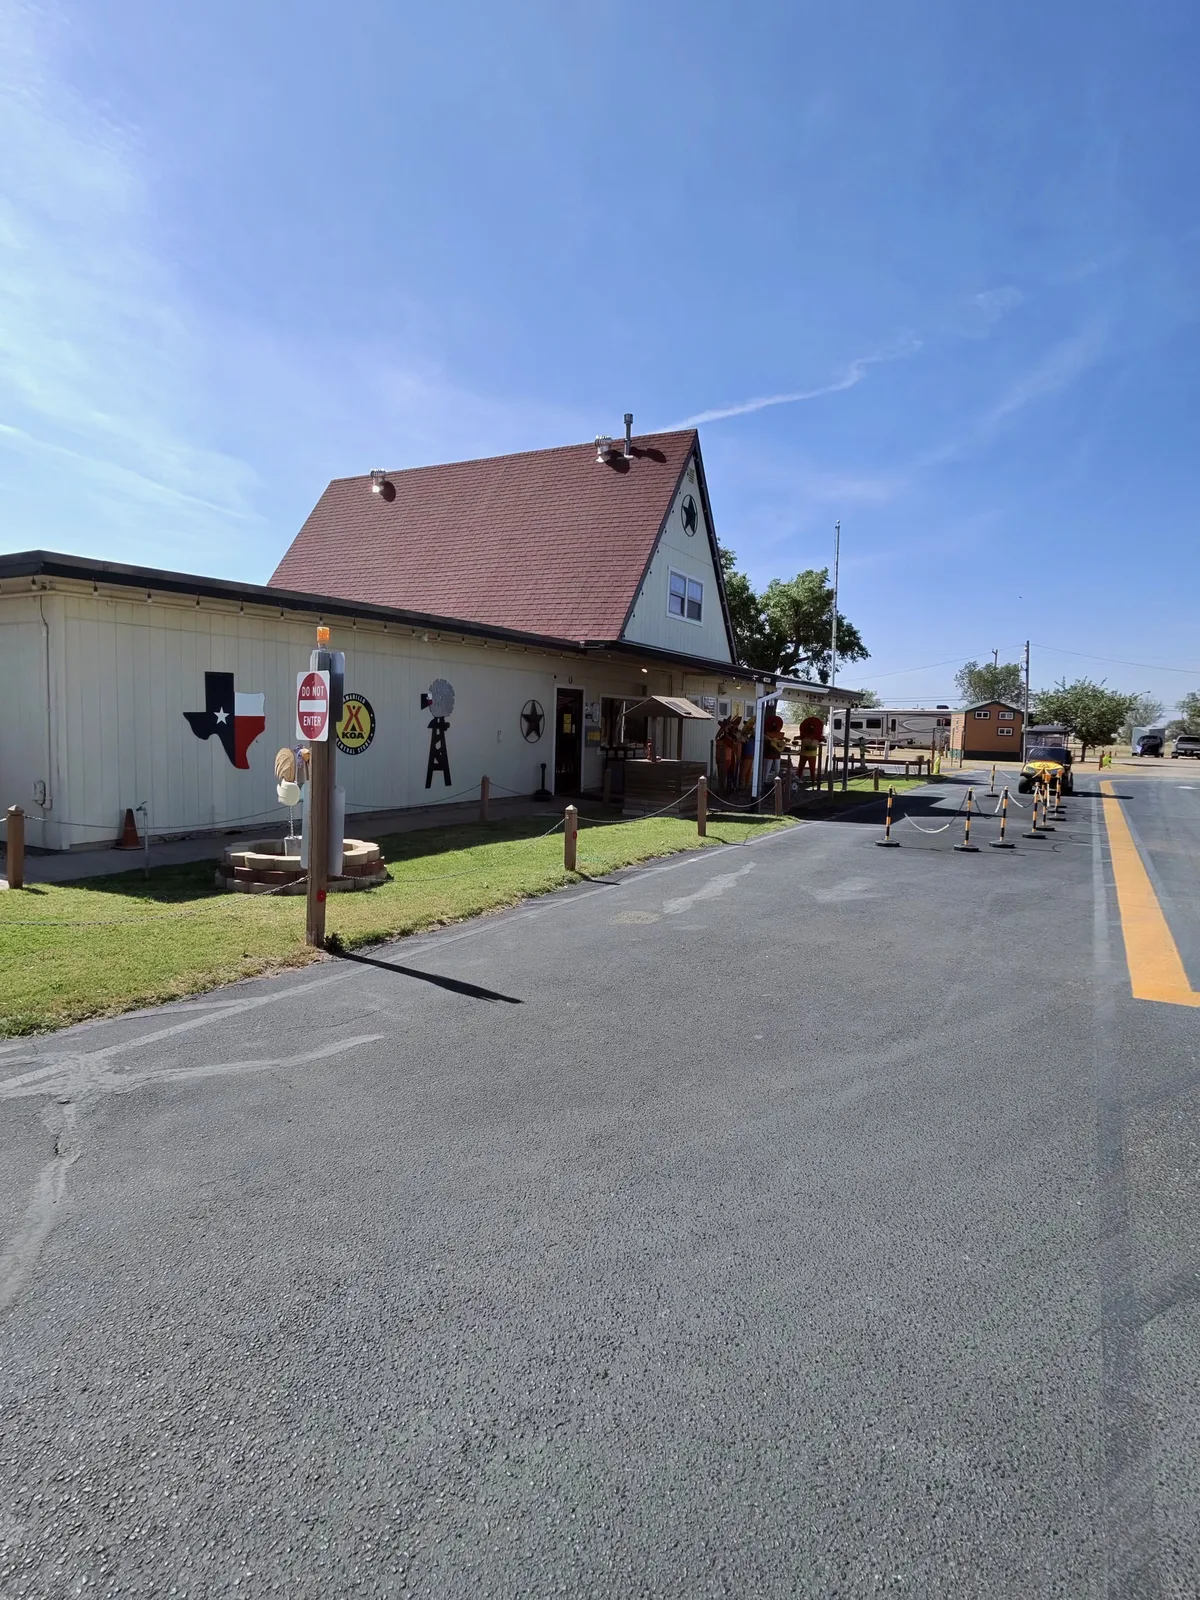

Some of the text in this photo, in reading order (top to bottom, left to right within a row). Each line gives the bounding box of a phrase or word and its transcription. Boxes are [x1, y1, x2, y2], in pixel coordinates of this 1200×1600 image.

[302, 686, 325, 697] DO NOT
[343, 694, 366, 704] MARILLO
[303, 716, 321, 726] ENTER
